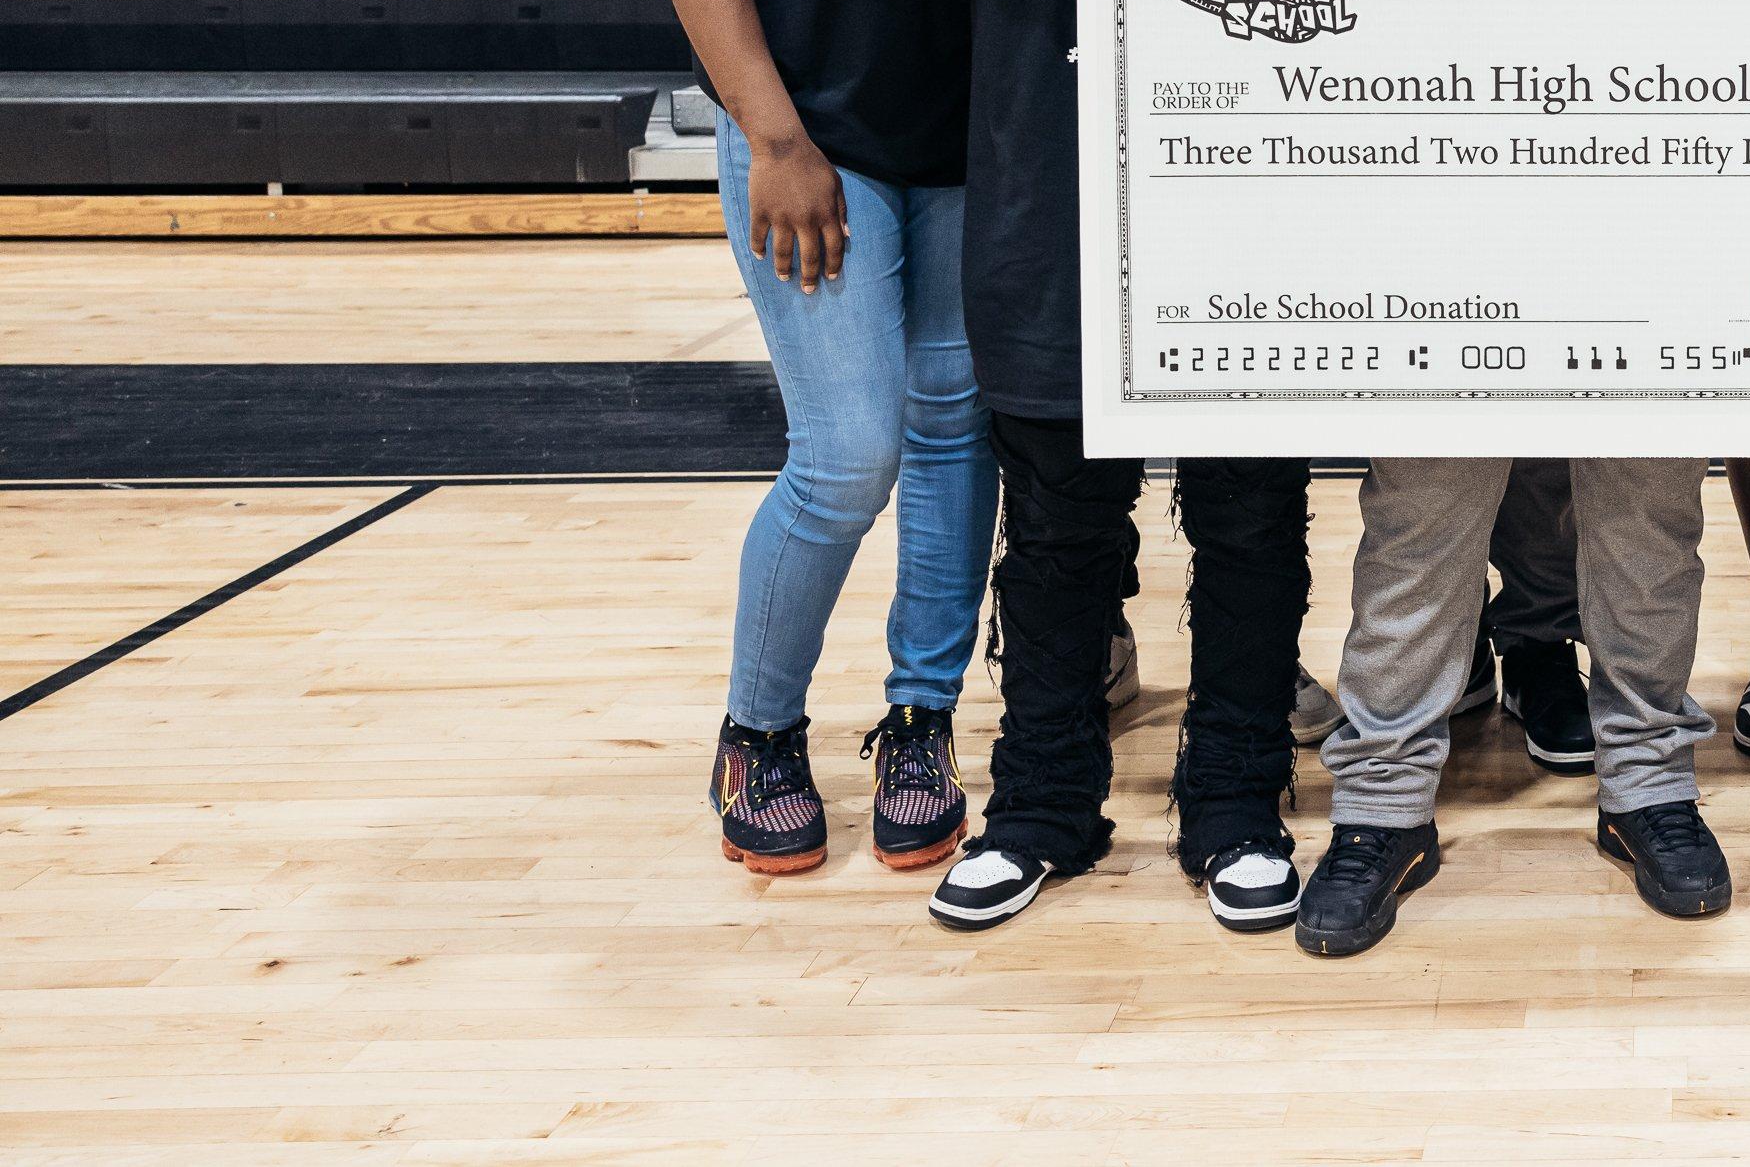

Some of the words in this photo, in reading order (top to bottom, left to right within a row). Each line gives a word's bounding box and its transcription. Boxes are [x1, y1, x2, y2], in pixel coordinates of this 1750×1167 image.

[1153, 82, 1183, 95] PAY
[1188, 82, 1211, 95] TO
[1216, 82, 1250, 95] THE
[1272, 63, 1475, 102] Wenonah
[1490, 64, 1592, 114] High
[1609, 64, 1750, 102] School
[1153, 96, 1211, 109] ORDER
[1216, 96, 1239, 109] OF
[1159, 136, 1252, 165] Three
[1263, 136, 1420, 165] Thousand
[1430, 137, 1499, 165] Two
[1510, 136, 1650, 165] Hundred
[1662, 135, 1731, 174] Fifty
[1157, 305, 1190, 319] FOR
[1208, 293, 1267, 320] Sole
[1277, 293, 1374, 320] School
[1384, 293, 1521, 320] Donation
